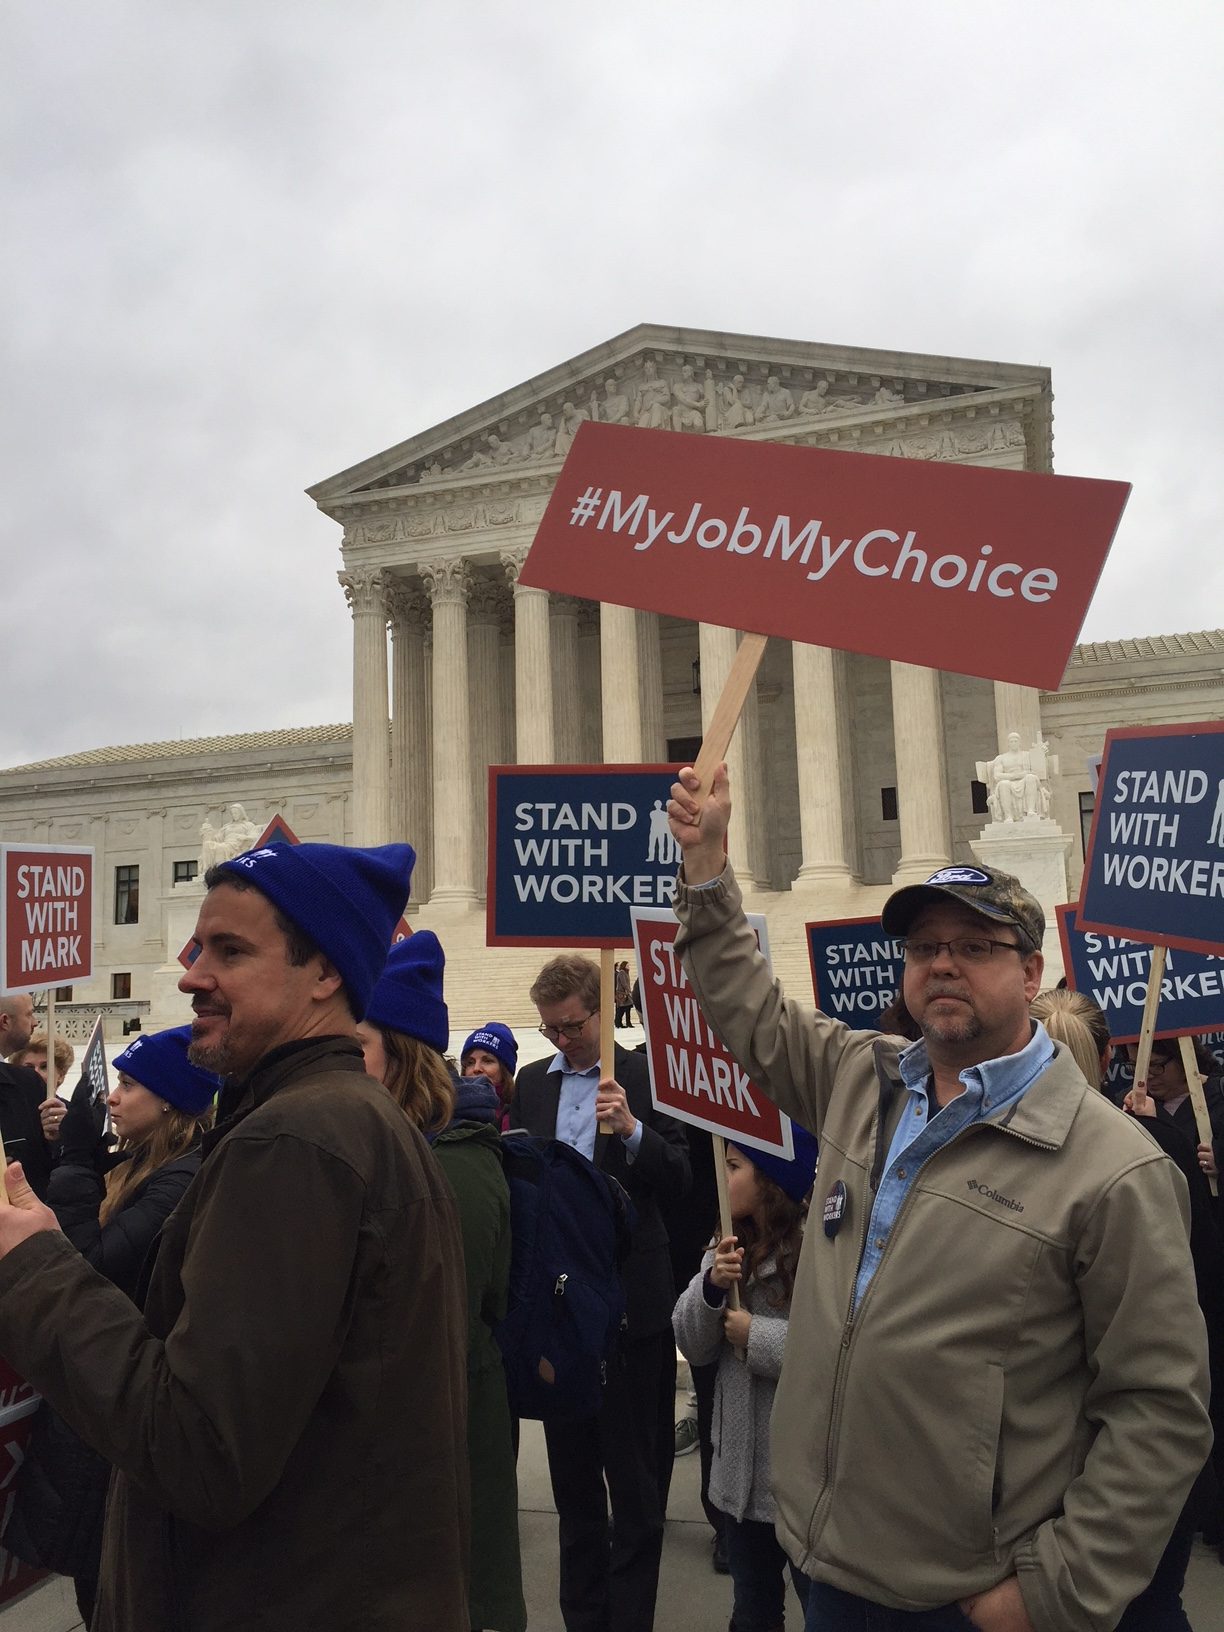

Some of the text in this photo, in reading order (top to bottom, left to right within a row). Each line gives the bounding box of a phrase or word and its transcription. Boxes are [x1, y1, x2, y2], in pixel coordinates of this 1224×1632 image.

[569, 486, 1058, 603] #MyJobMyChoice
[1113, 769, 1209, 804] STAND
[514, 802, 638, 831] STAND
[1110, 812, 1180, 848] WITH
[513, 838, 609, 867] WITH
[17, 864, 85, 899] STAND
[25, 900, 78, 935] WITH
[21, 934, 82, 973] MARK
[827, 964, 895, 989] WITH
[1092, 970, 1224, 1011] WORKE
[830, 988, 900, 1013] WOR
[665, 1044, 761, 1118] MARK
[978, 1184, 1025, 1213] Columbia
